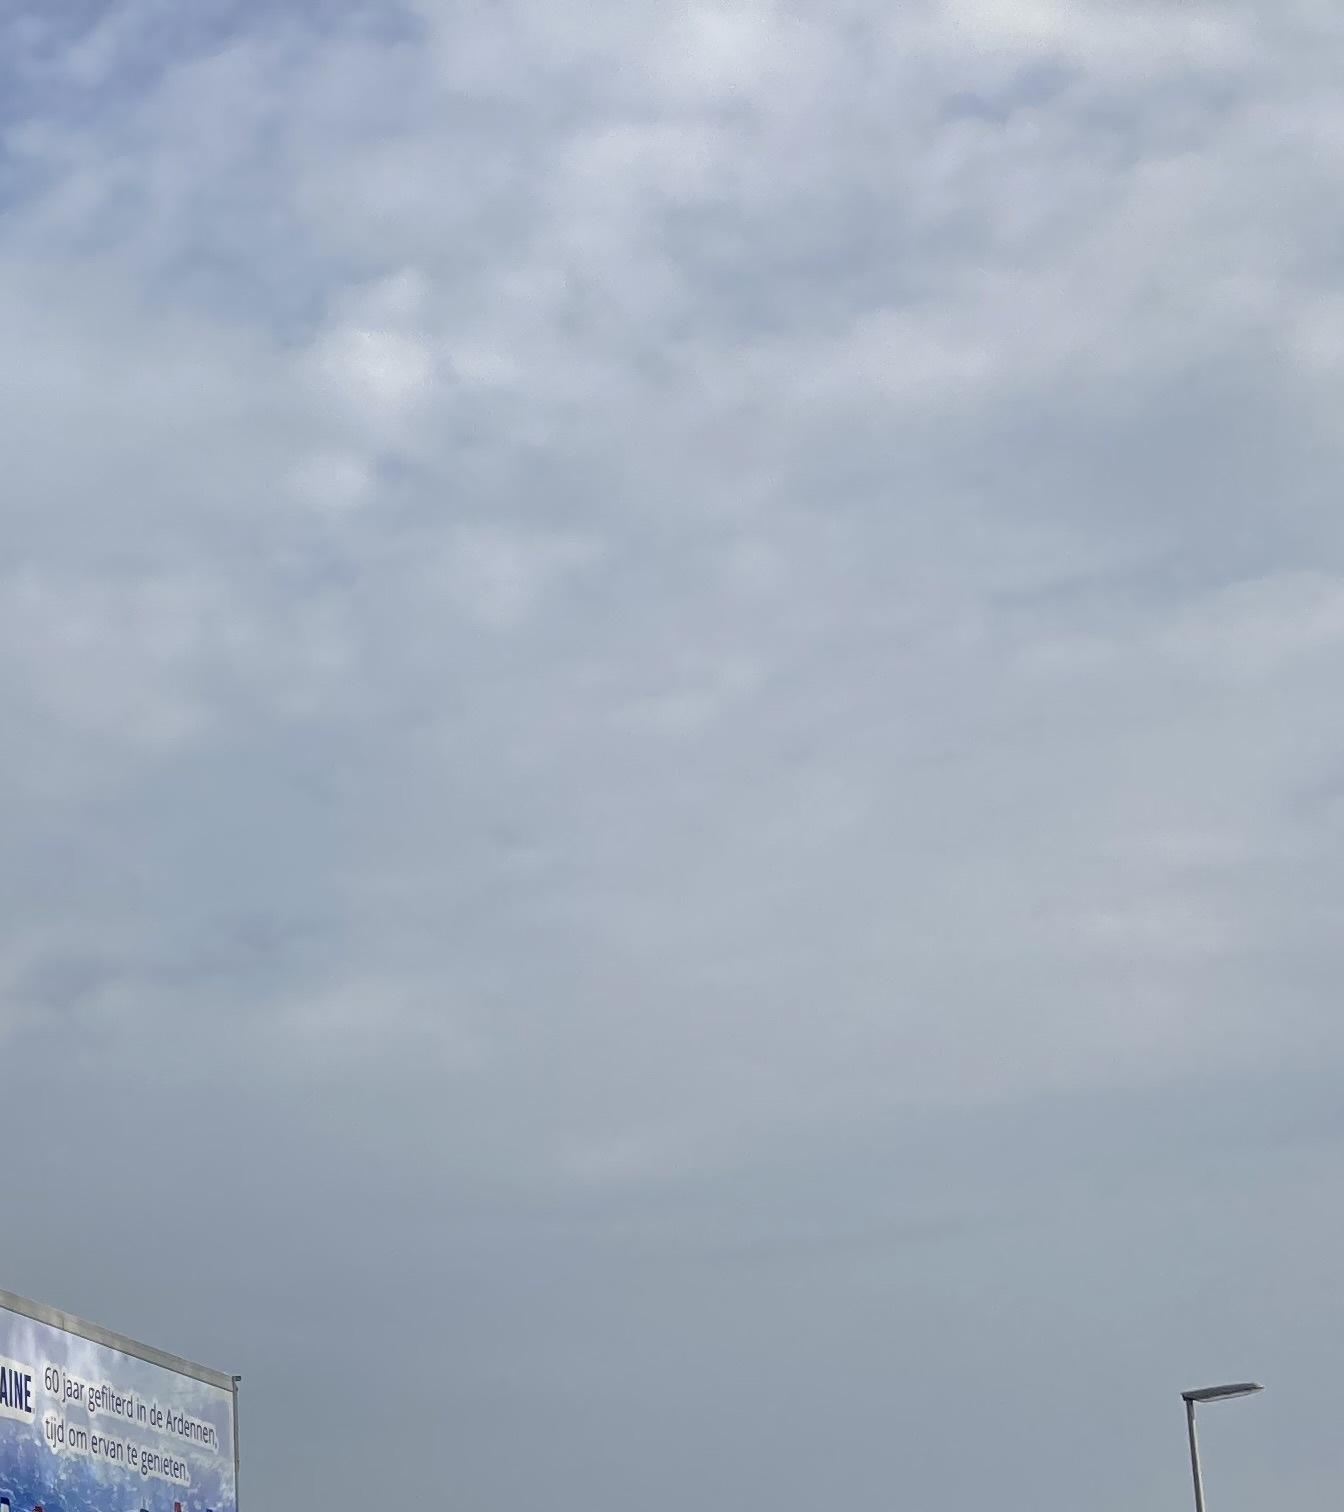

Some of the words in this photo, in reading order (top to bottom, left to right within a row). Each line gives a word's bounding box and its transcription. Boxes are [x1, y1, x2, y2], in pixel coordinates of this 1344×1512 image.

[44, 1366, 60, 1393] 60
[61, 1372, 85, 1403] jaar
[87, 1385, 134, 1418] gefilterd
[136, 1400, 147, 1422] in
[149, 1403, 163, 1429] de
[166, 1409, 218, 1450] Ardennen,
[44, 1416, 64, 1448] tijd
[68, 1427, 88, 1451] om
[91, 1434, 124, 1462] ervan
[126, 1443, 138, 1466] te
[140, 1450, 190, 1482] genieten.
